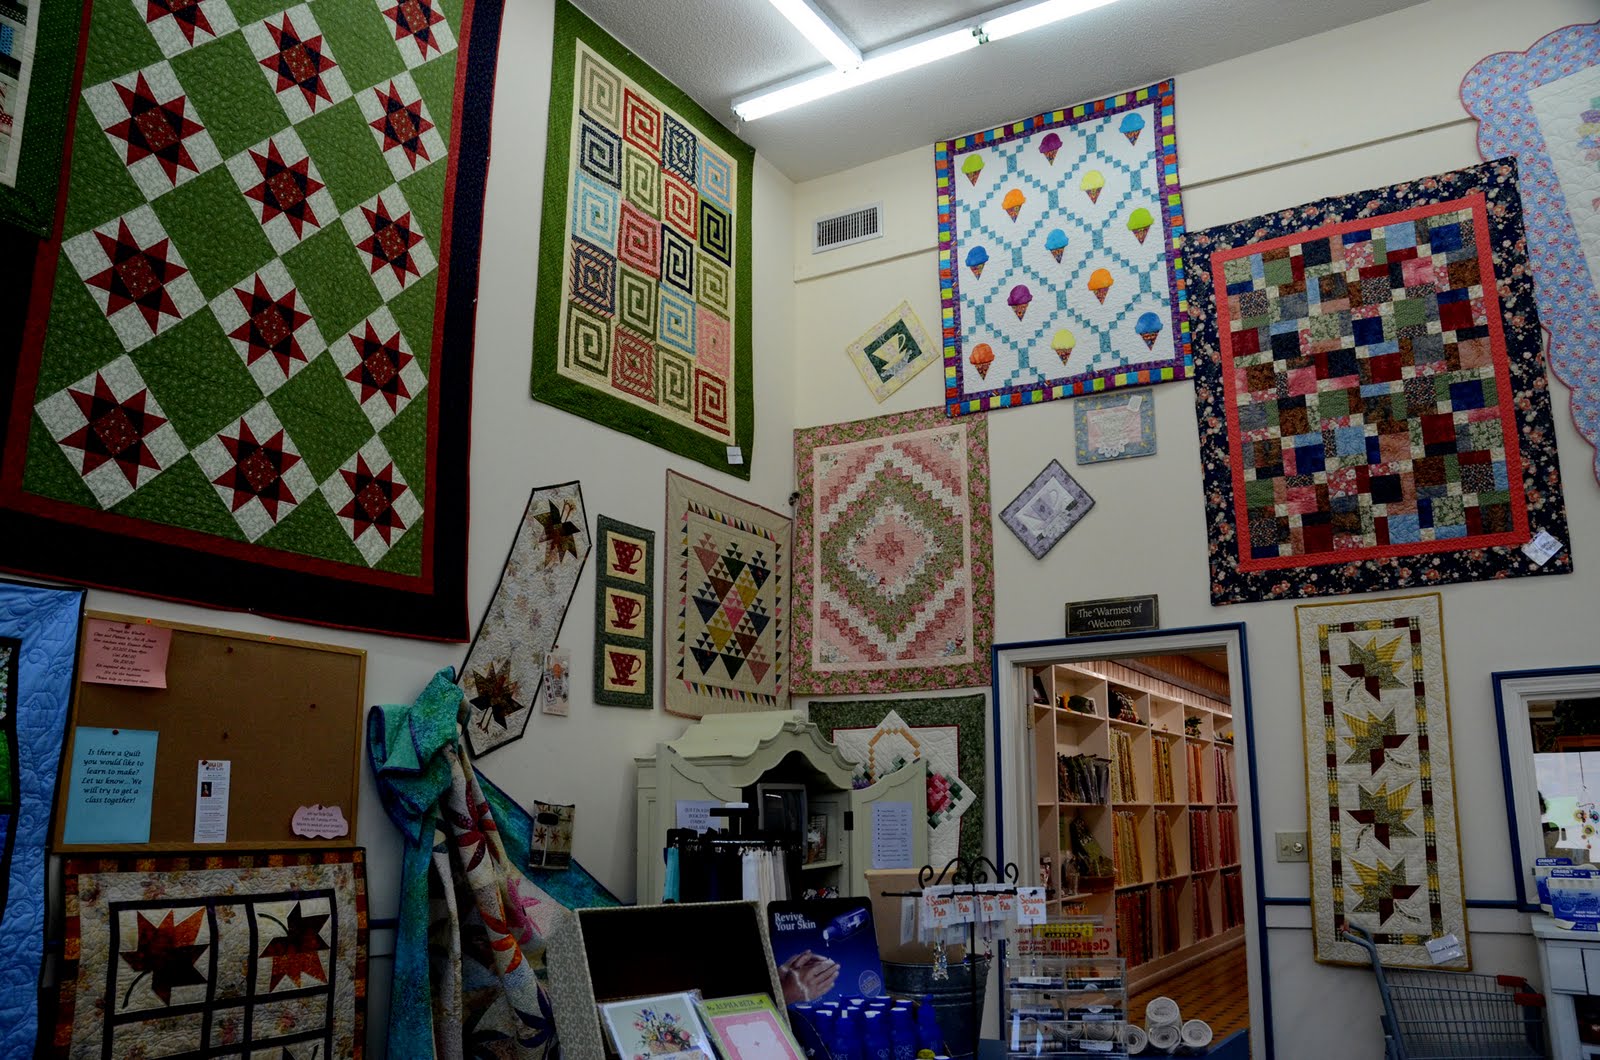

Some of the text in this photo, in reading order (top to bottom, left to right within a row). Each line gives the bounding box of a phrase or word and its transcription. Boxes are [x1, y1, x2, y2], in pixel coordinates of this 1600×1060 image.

[1077, 603, 1143, 618] The Warmest of
[1088, 619, 1131, 628] Welcomes
[120, 788, 135, 796] get
[104, 797, 136, 806] together!
[1020, 895, 1045, 905] Scissor
[774, 912, 804, 922] Revive
[776, 920, 816, 931] Your Skin
